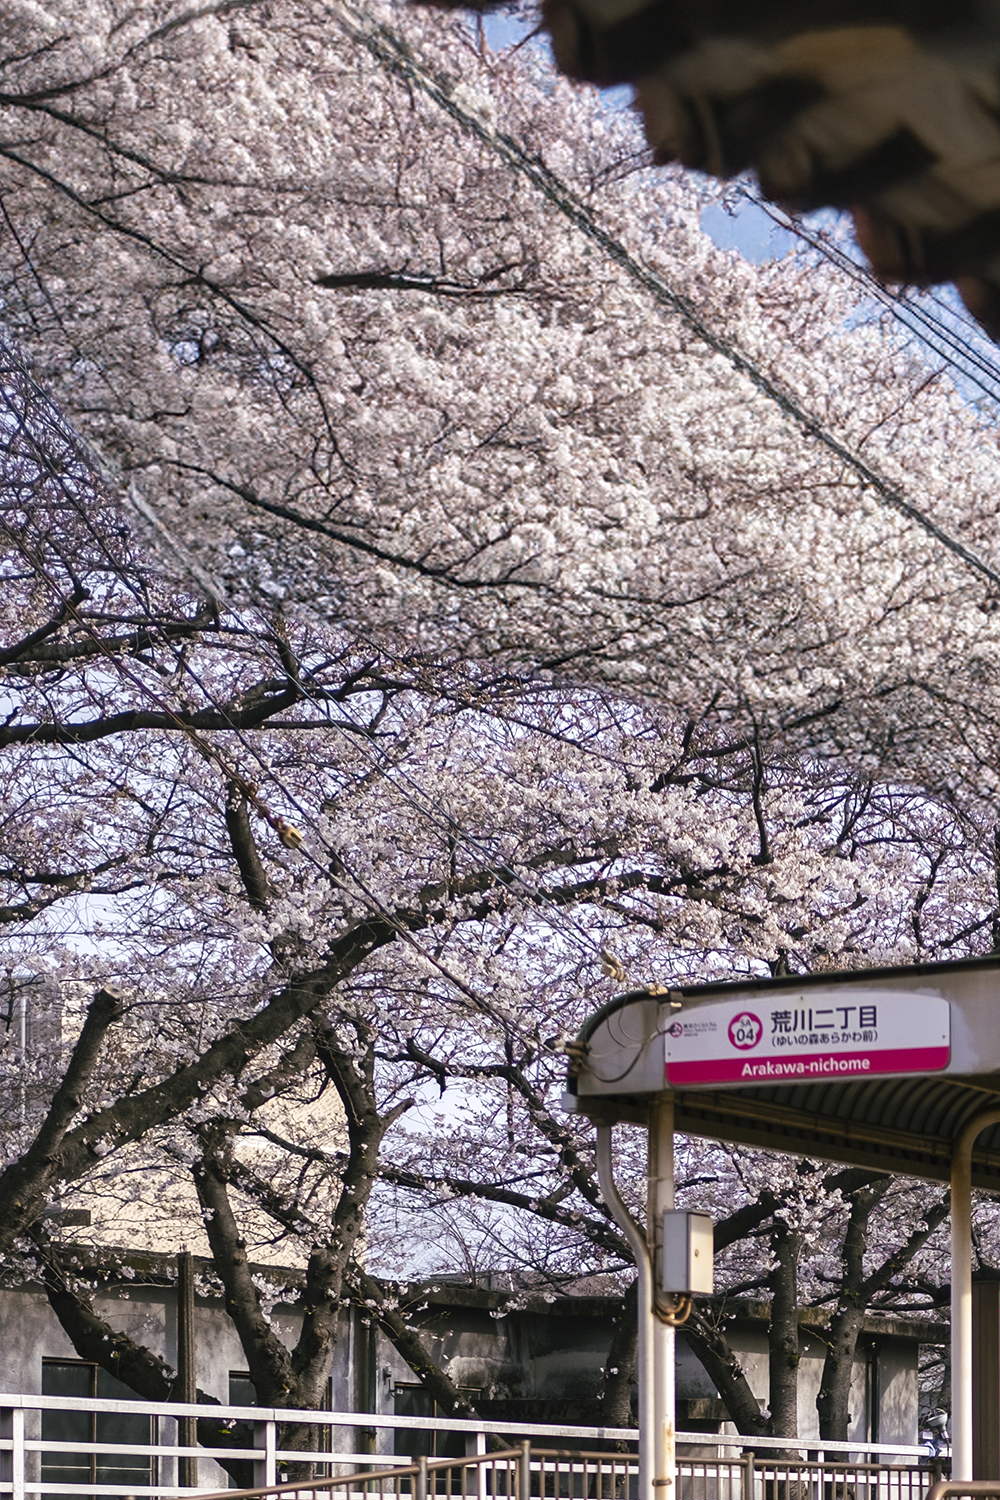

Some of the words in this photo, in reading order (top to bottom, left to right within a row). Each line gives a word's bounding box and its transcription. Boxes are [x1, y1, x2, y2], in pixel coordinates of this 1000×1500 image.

[740, 1019, 752, 1028] SA
[770, 1005, 878, 1033] 荒川二丁目
[736, 1028, 755, 1042] 04
[741, 1056, 871, 1077] Arakawa-nichome
